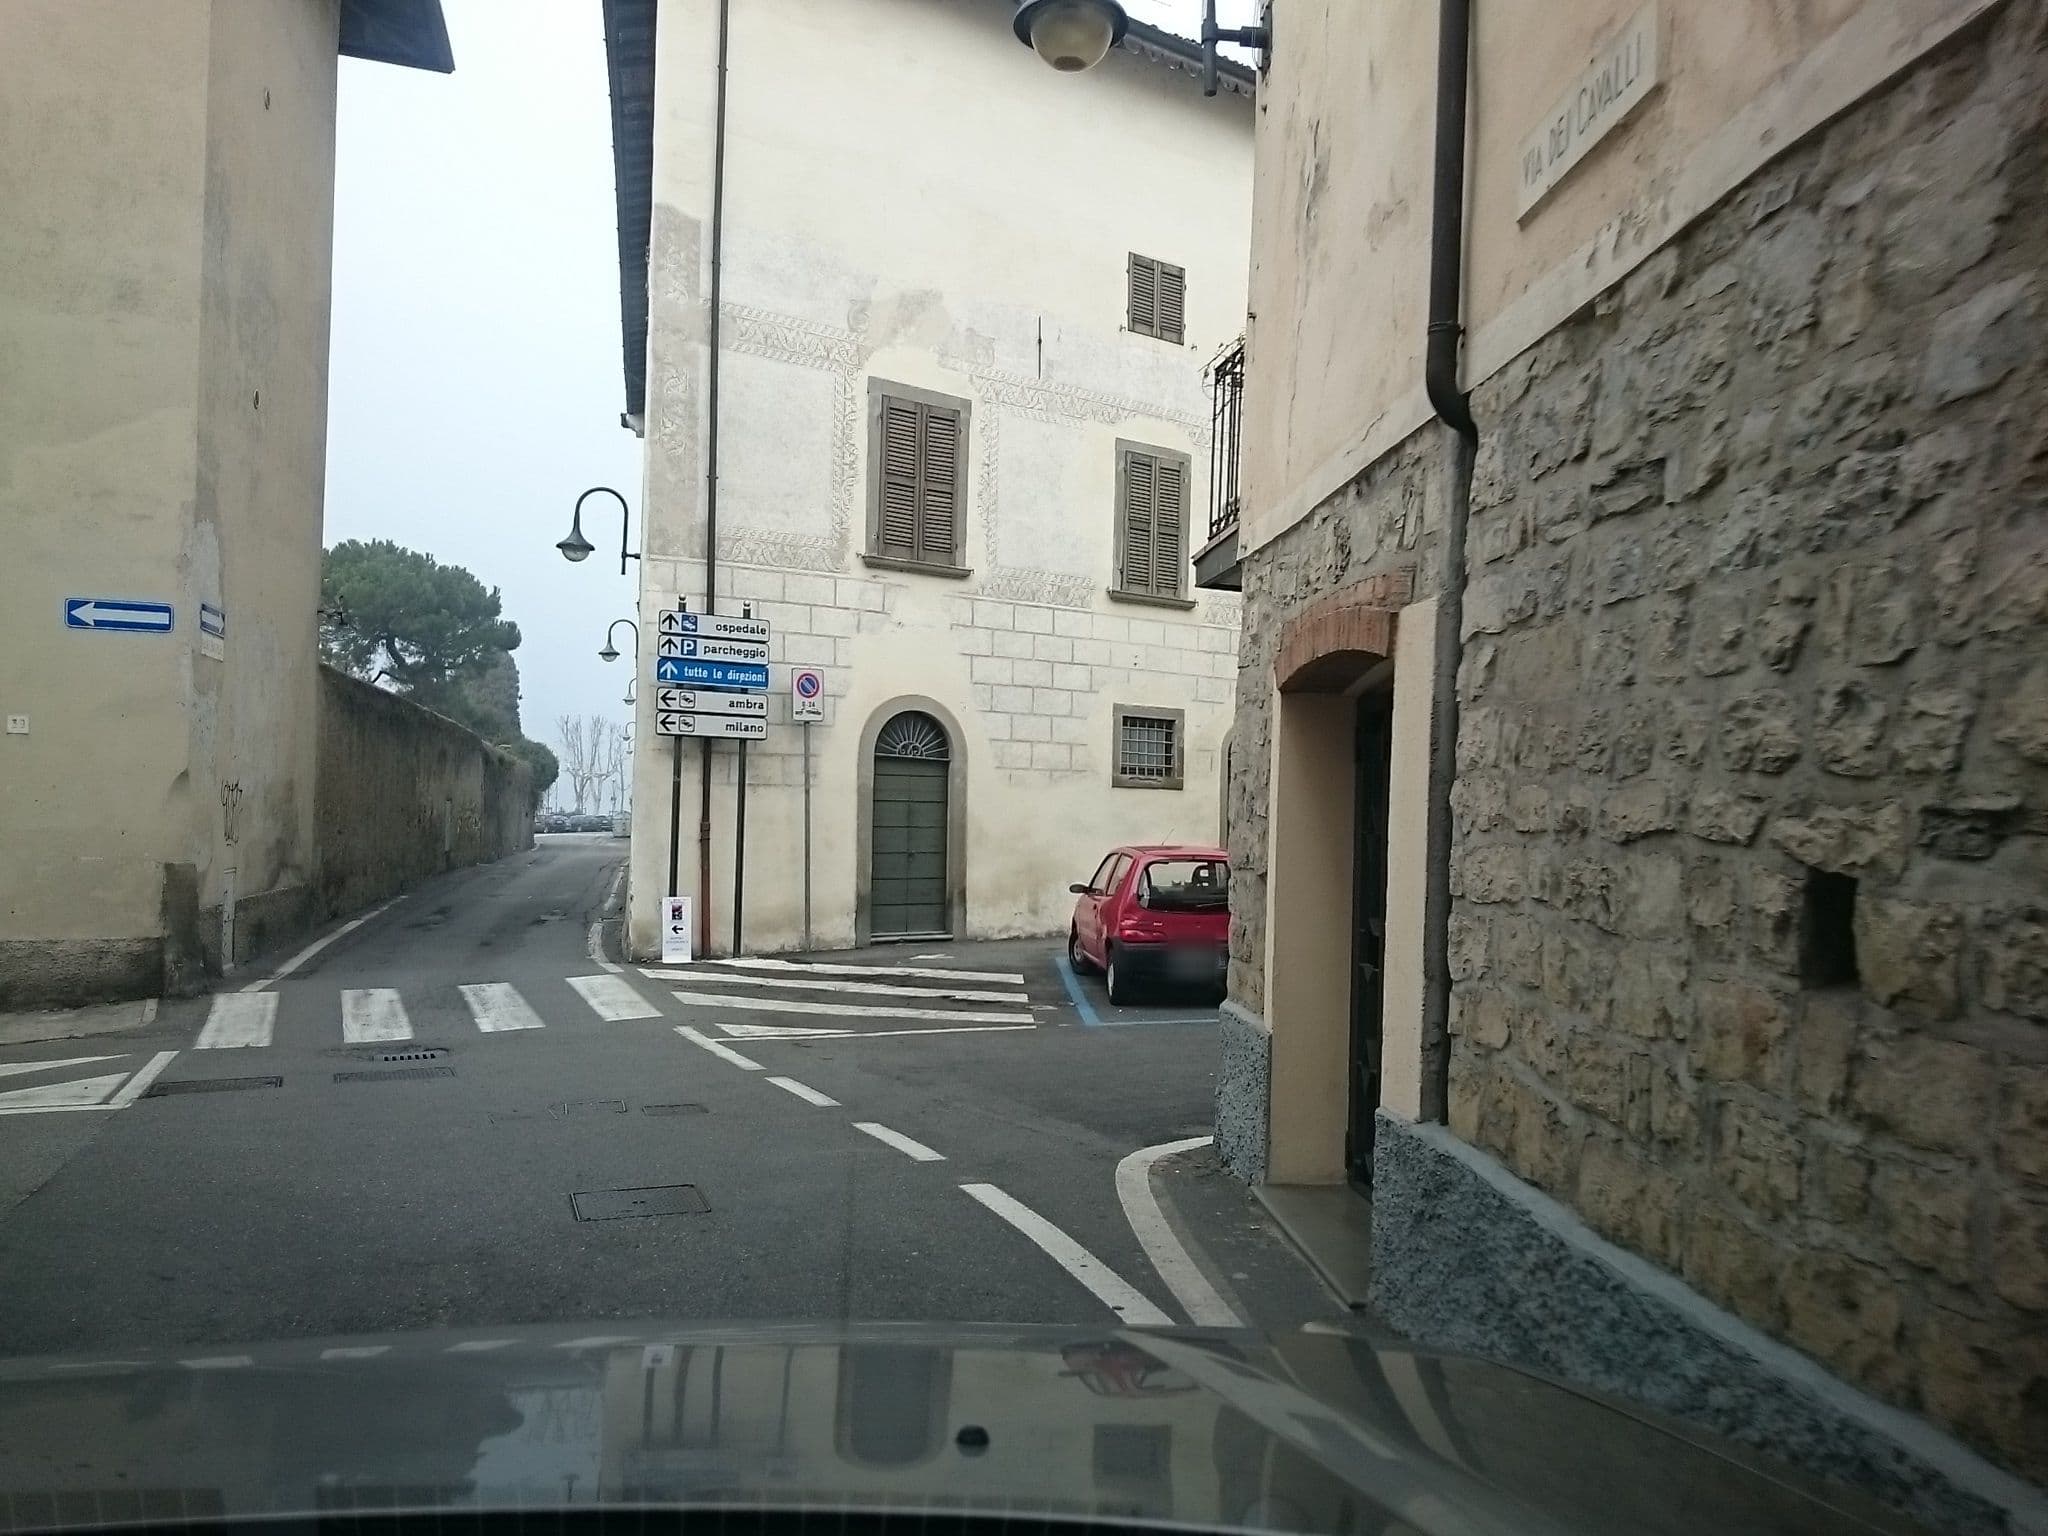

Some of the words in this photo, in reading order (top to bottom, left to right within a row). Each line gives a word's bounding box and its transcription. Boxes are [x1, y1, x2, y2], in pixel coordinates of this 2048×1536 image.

[1523, 147, 1542, 189] VIA
[1549, 109, 1571, 167] DEI
[1577, 34, 1641, 136] CAVALLI
[716, 625, 766, 635] ospedale
[683, 641, 693, 655] P
[704, 645, 765, 658] parcheggio
[684, 666, 708, 678] tutte
[713, 668, 723, 679] le
[727, 670, 766, 683] direzioni
[728, 699, 764, 710] ambra
[725, 722, 764, 733] milano
